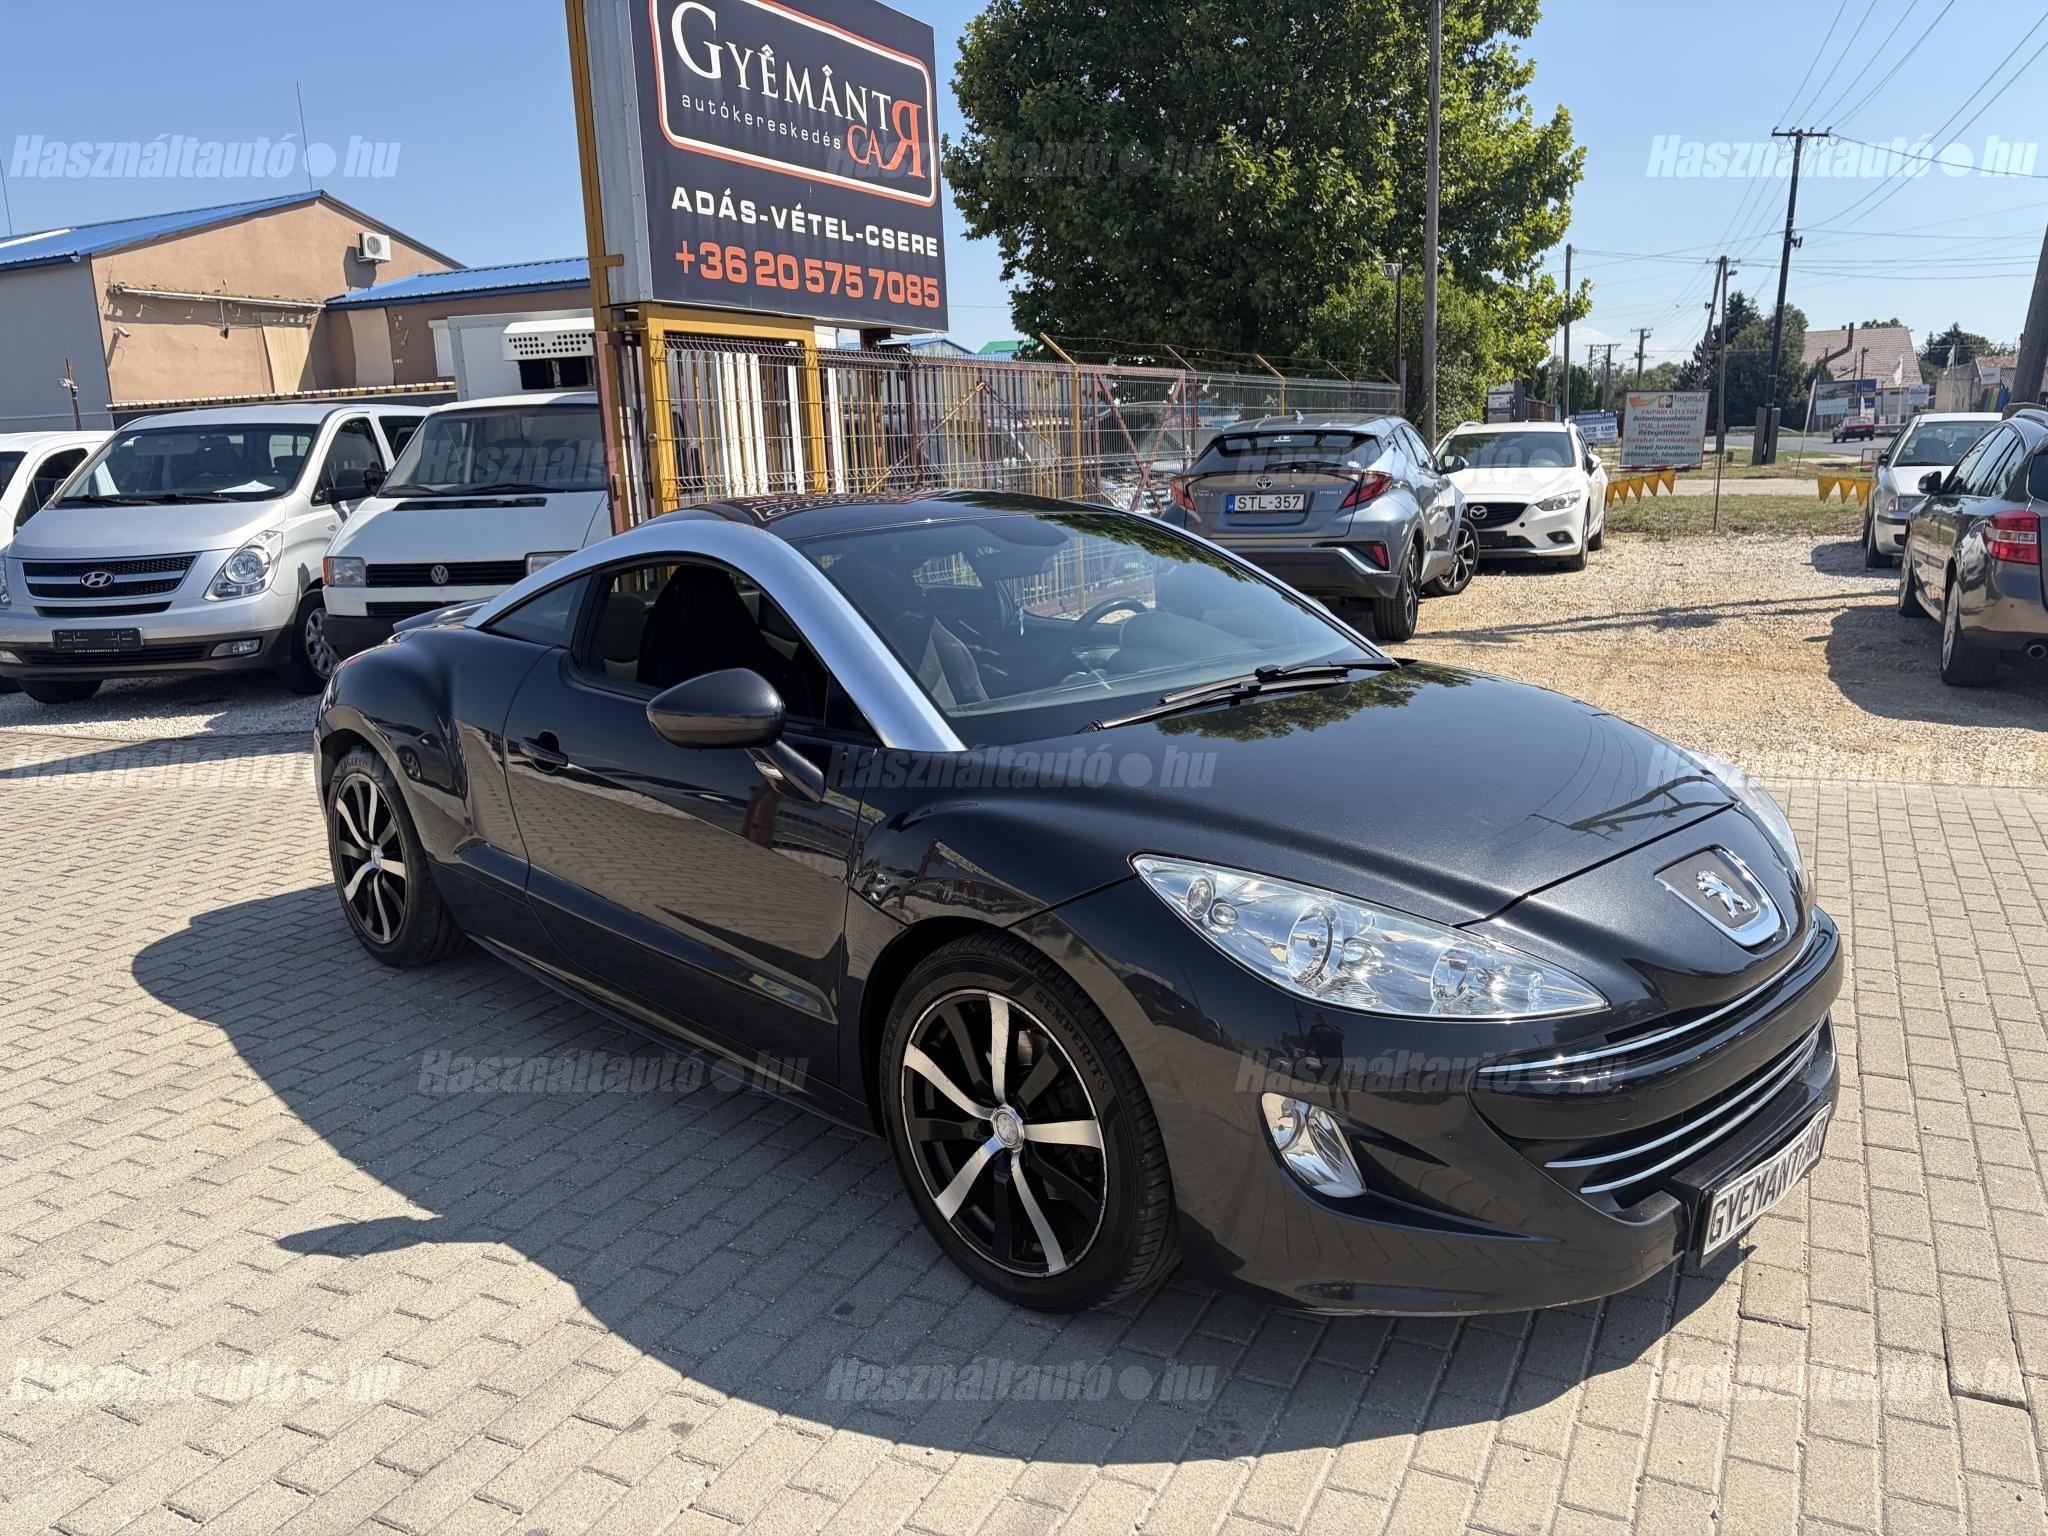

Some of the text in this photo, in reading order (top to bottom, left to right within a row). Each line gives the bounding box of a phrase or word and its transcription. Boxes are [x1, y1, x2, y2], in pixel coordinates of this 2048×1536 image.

[682, 95, 842, 150] autókereskedés
[671, 187, 939, 257] ADÁS-VÉTEL-CSERE
[675, 240, 940, 308] +36 20 575 7085
[1238, 496, 1301, 510] STL-357
